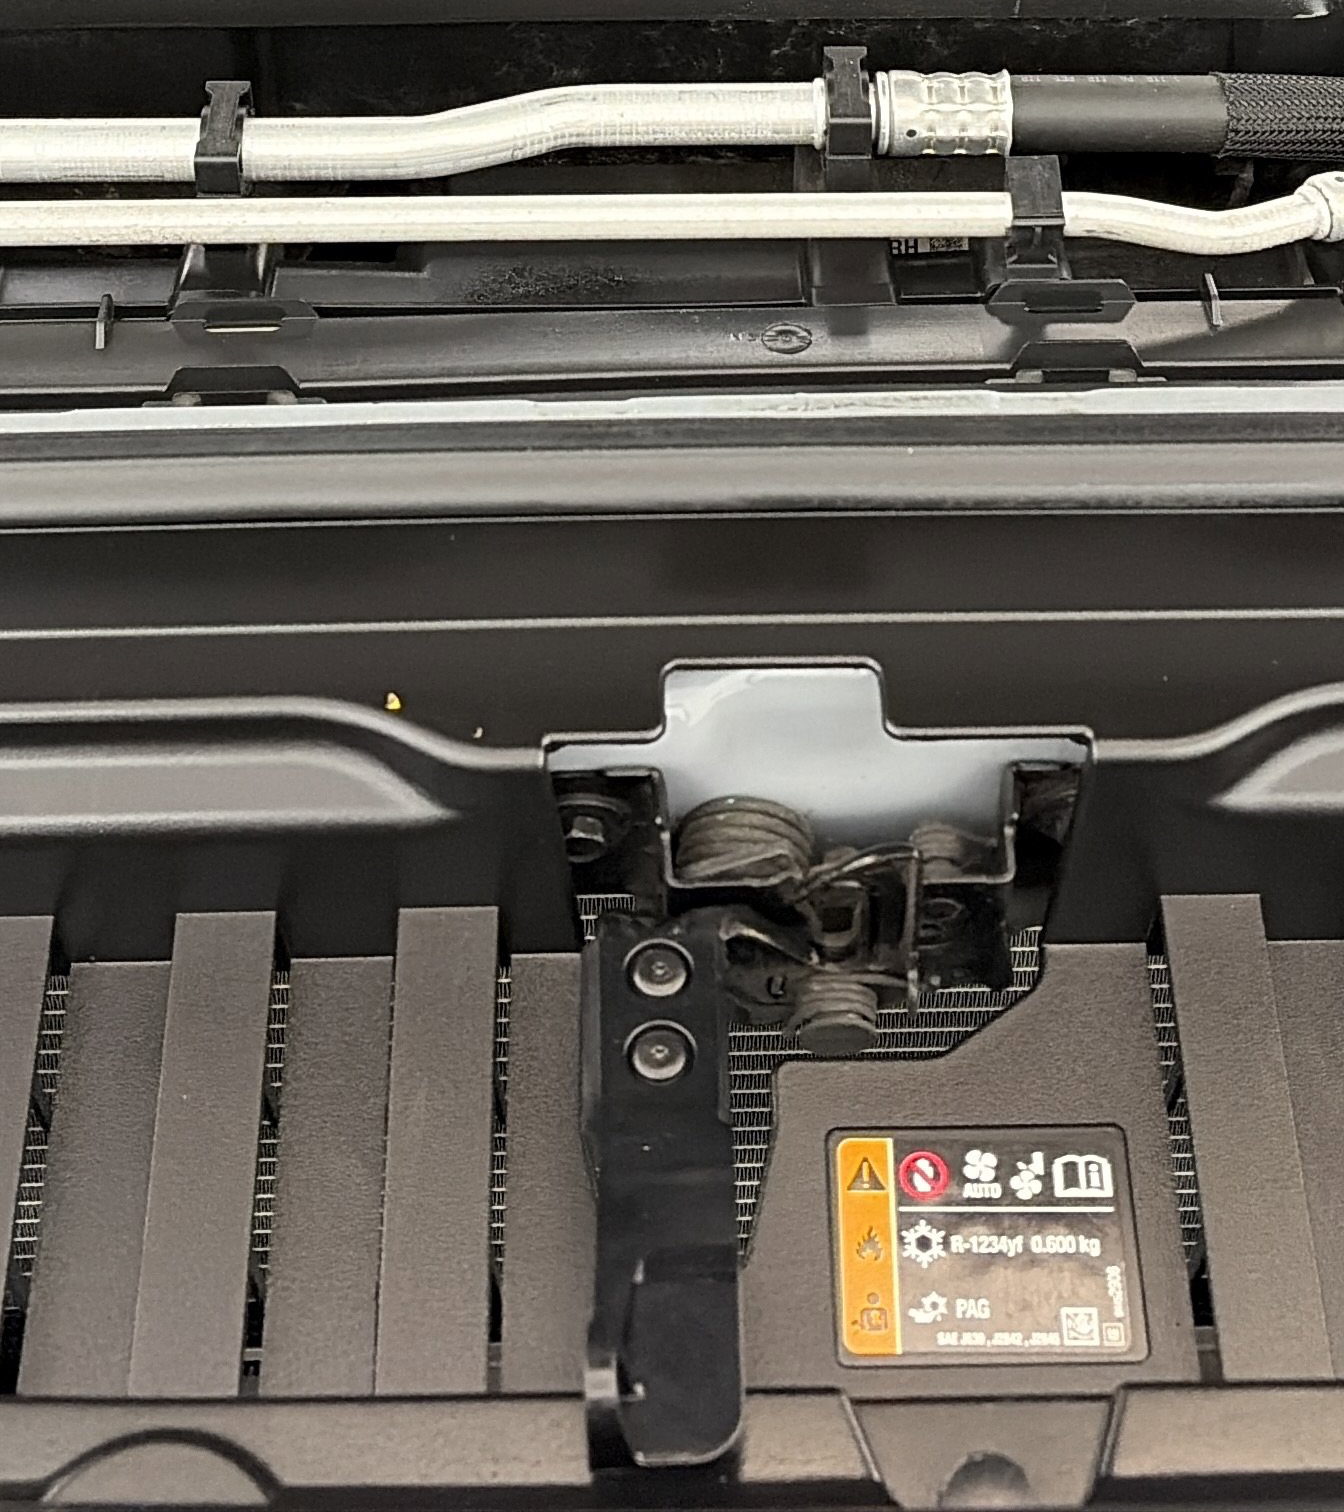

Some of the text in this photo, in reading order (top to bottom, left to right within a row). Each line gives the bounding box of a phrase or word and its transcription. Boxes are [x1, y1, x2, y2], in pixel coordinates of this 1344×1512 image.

[963, 1183, 1002, 1198] AUTO
[950, 1234, 1101, 1257] R-1234yf 0.600 kg
[956, 1298, 991, 1320] PAG
